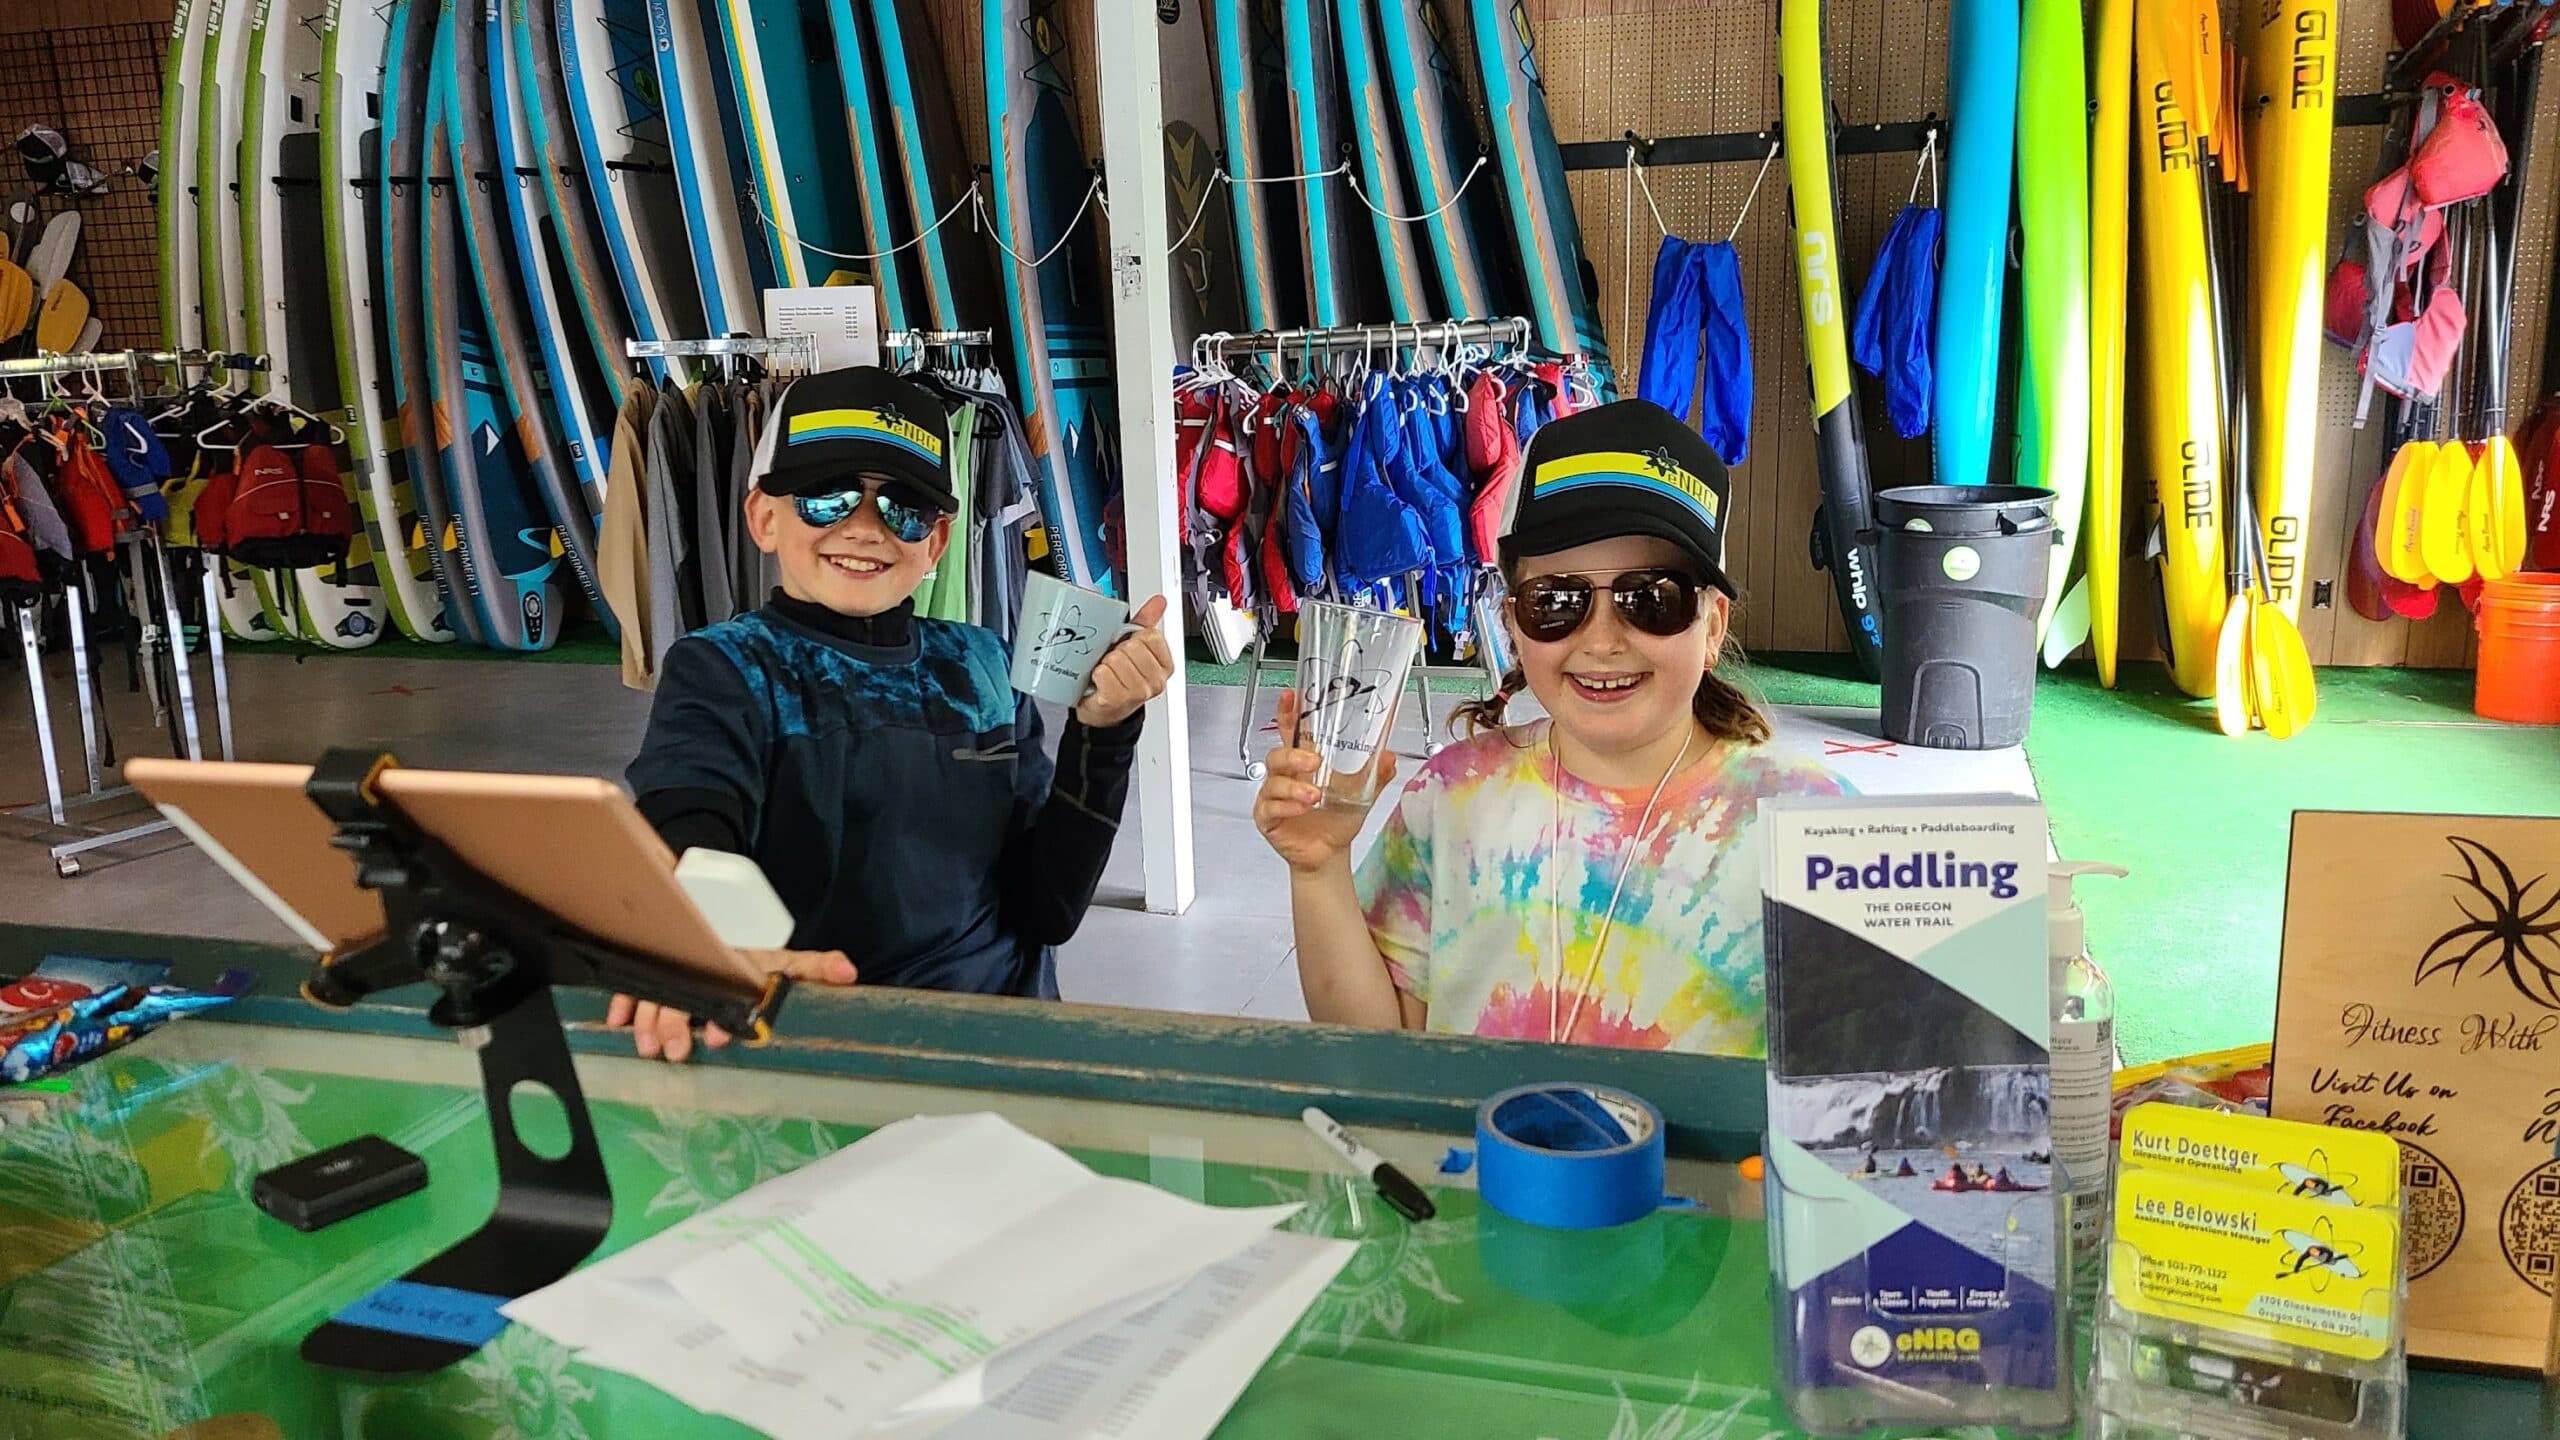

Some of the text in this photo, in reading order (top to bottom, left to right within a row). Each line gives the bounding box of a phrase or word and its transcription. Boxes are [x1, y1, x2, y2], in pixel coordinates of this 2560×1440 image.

[2291, 10, 2327, 109] GLIDE
[2155, 80, 2191, 172] GLIDE
[1804, 231, 1833, 326] nrs
[893, 422, 936, 452] eNRG
[1668, 470, 1713, 511] eNRG
[2181, 440, 2213, 529] GLIDE
[2537, 489, 2556, 532] NRS
[453, 513, 476, 583] PERFORMER
[556, 524, 593, 590] PERFORMER
[2266, 515, 2298, 603] GLIDE
[1847, 547, 1867, 610] whip
[1804, 822, 2016, 837] Kayaking Rafting Paddleboarding
[1806, 850, 2019, 899] Paddling
[1864, 917, 1954, 928] WATER TRAIL
[1865, 901, 1952, 914] THE OREGON
[2341, 1002, 2559, 1055] Fitness With
[2310, 1066, 2458, 1099] Visit Us on
[2323, 1103, 2438, 1137] Facebook
[2132, 1149, 2243, 1174] Director of Operations
[2133, 1129, 2171, 1150] Kurt
[2178, 1137, 2259, 1167] Doettger
[2134, 1214, 2271, 1245] Assistant Operations Manager
[2135, 1193, 2258, 1232] Lee Belowski
[1895, 1327, 1981, 1352] eNRG
